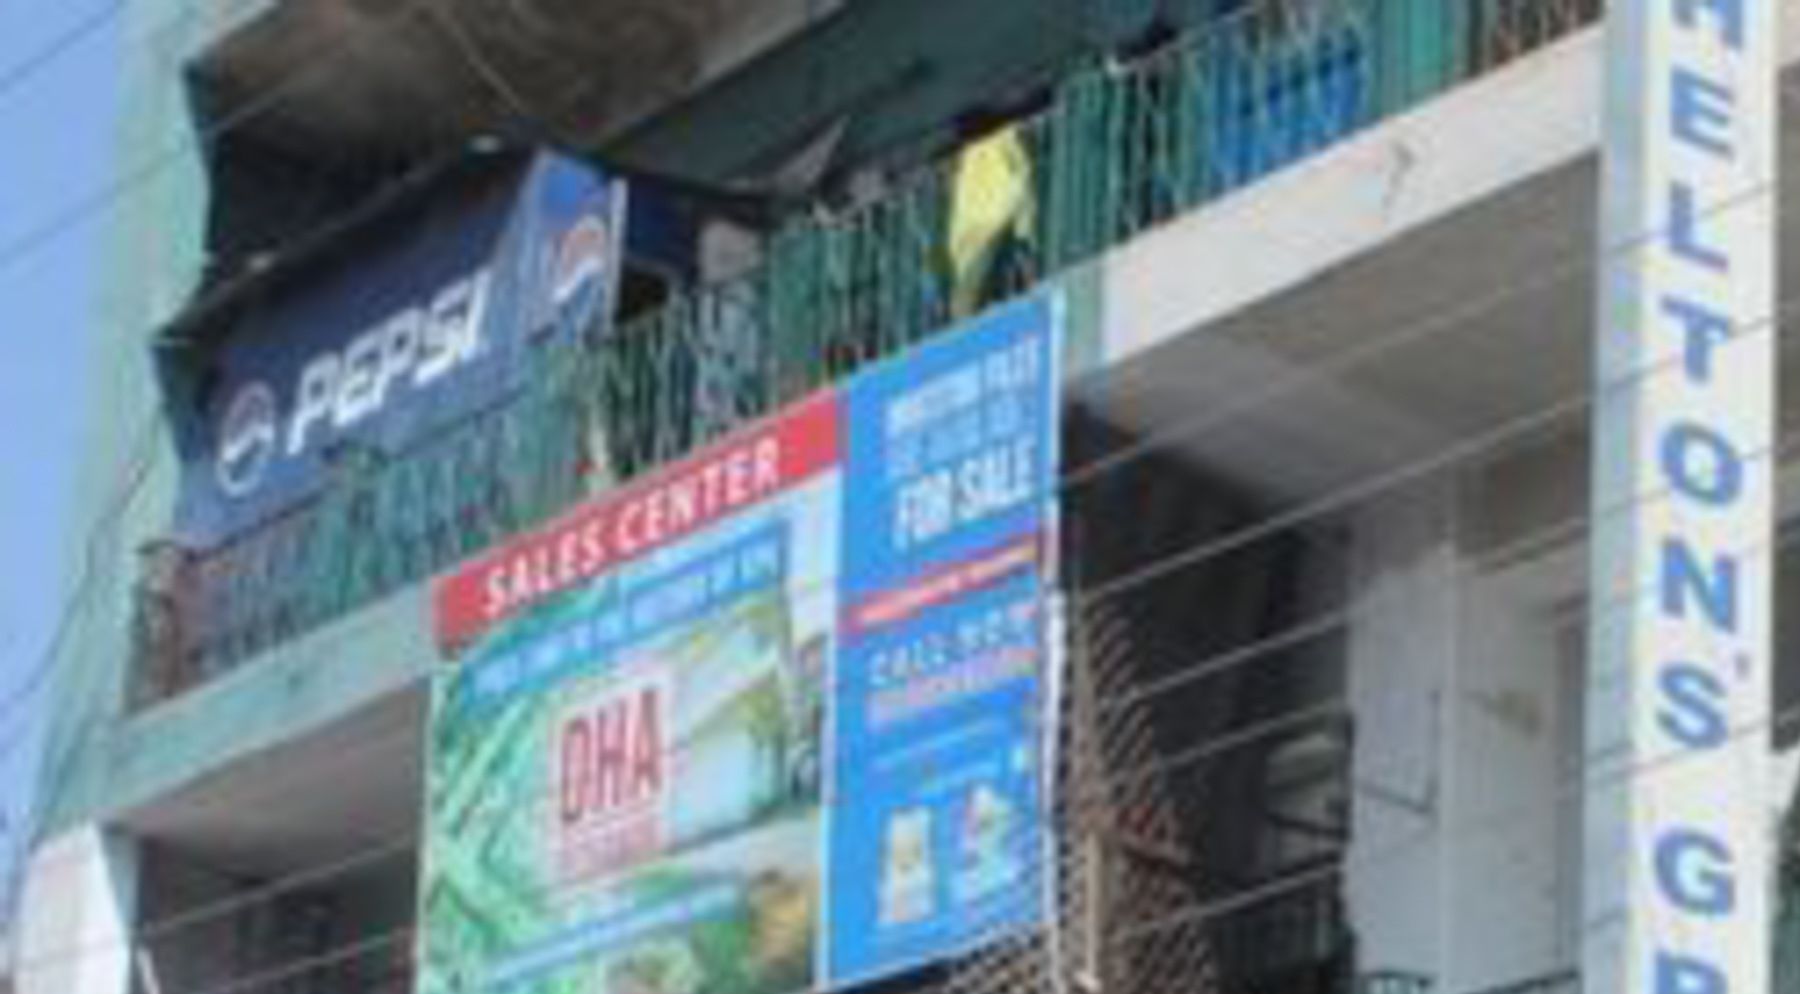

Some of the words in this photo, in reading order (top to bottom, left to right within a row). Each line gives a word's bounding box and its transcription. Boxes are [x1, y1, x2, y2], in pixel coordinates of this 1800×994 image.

[286, 267, 494, 456] PEPSI
[480, 514, 603, 620] SALES
[616, 436, 783, 558] CENTER
[561, 689, 661, 823] DHA
